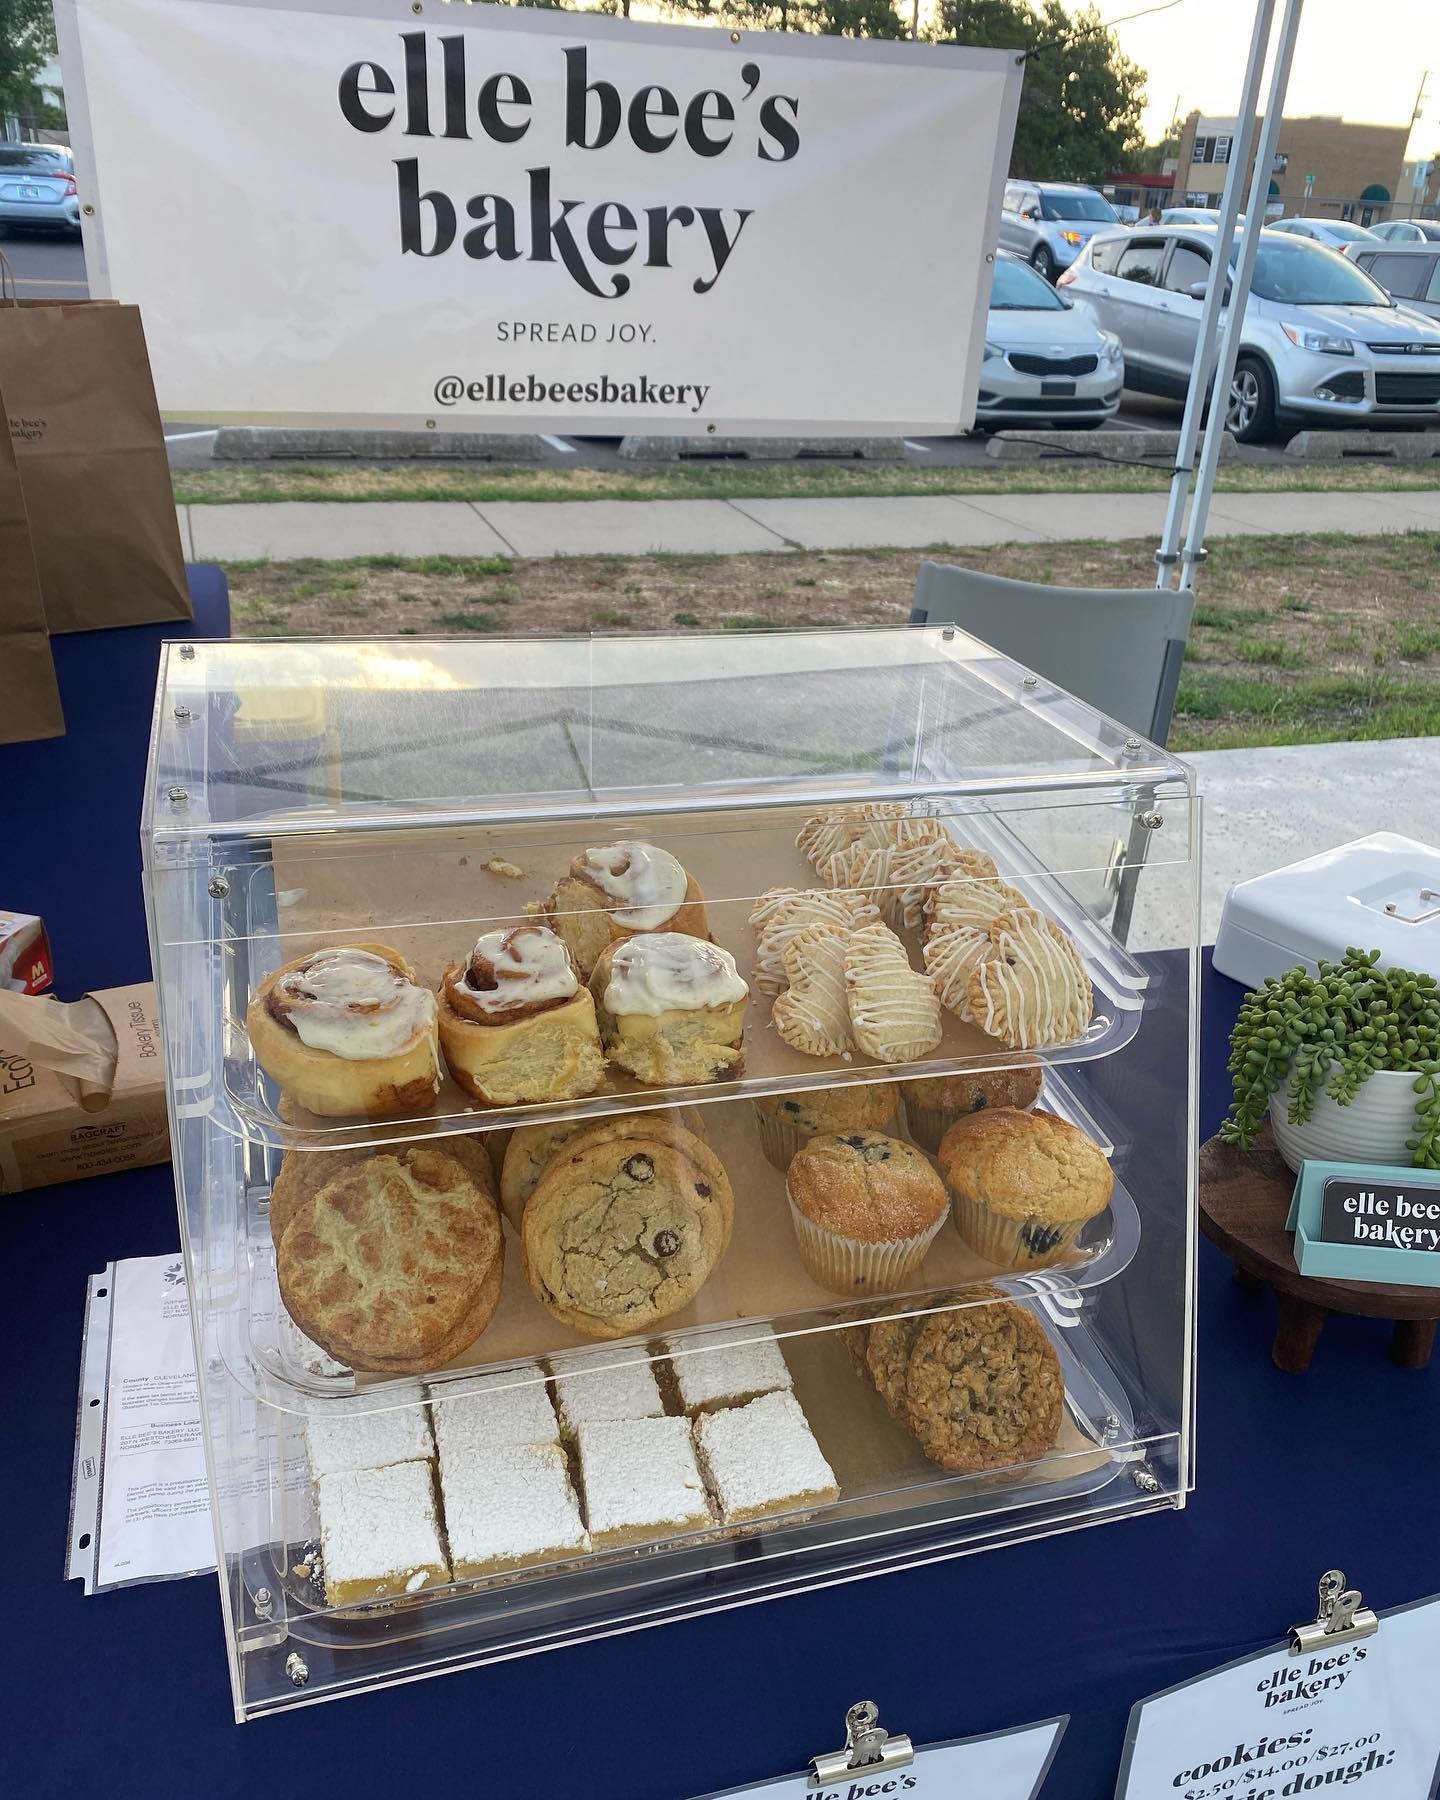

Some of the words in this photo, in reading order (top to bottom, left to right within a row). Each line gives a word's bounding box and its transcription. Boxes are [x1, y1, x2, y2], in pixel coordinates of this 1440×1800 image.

[339, 31, 532, 144] elle
[563, 45, 801, 162] bee's
[393, 158, 754, 299] bakery
[497, 321, 597, 343] SPREAD
[604, 322, 657, 343] JOY.
[433, 374, 711, 413] @ellebeesbakery
[1343, 1192, 1390, 1216] elle
[1353, 1216, 1440, 1251] bakery
[123, 1376, 149, 1384] County
[1257, 1667, 1302, 1693] elle
[1307, 1646, 1367, 1677] bee's
[1264, 1669, 1353, 1709] bakery
[1172, 1728, 1314, 1788] cookies:
[1282, 1748, 1396, 1798] dough:
[846, 1773, 918, 1800] bee's
